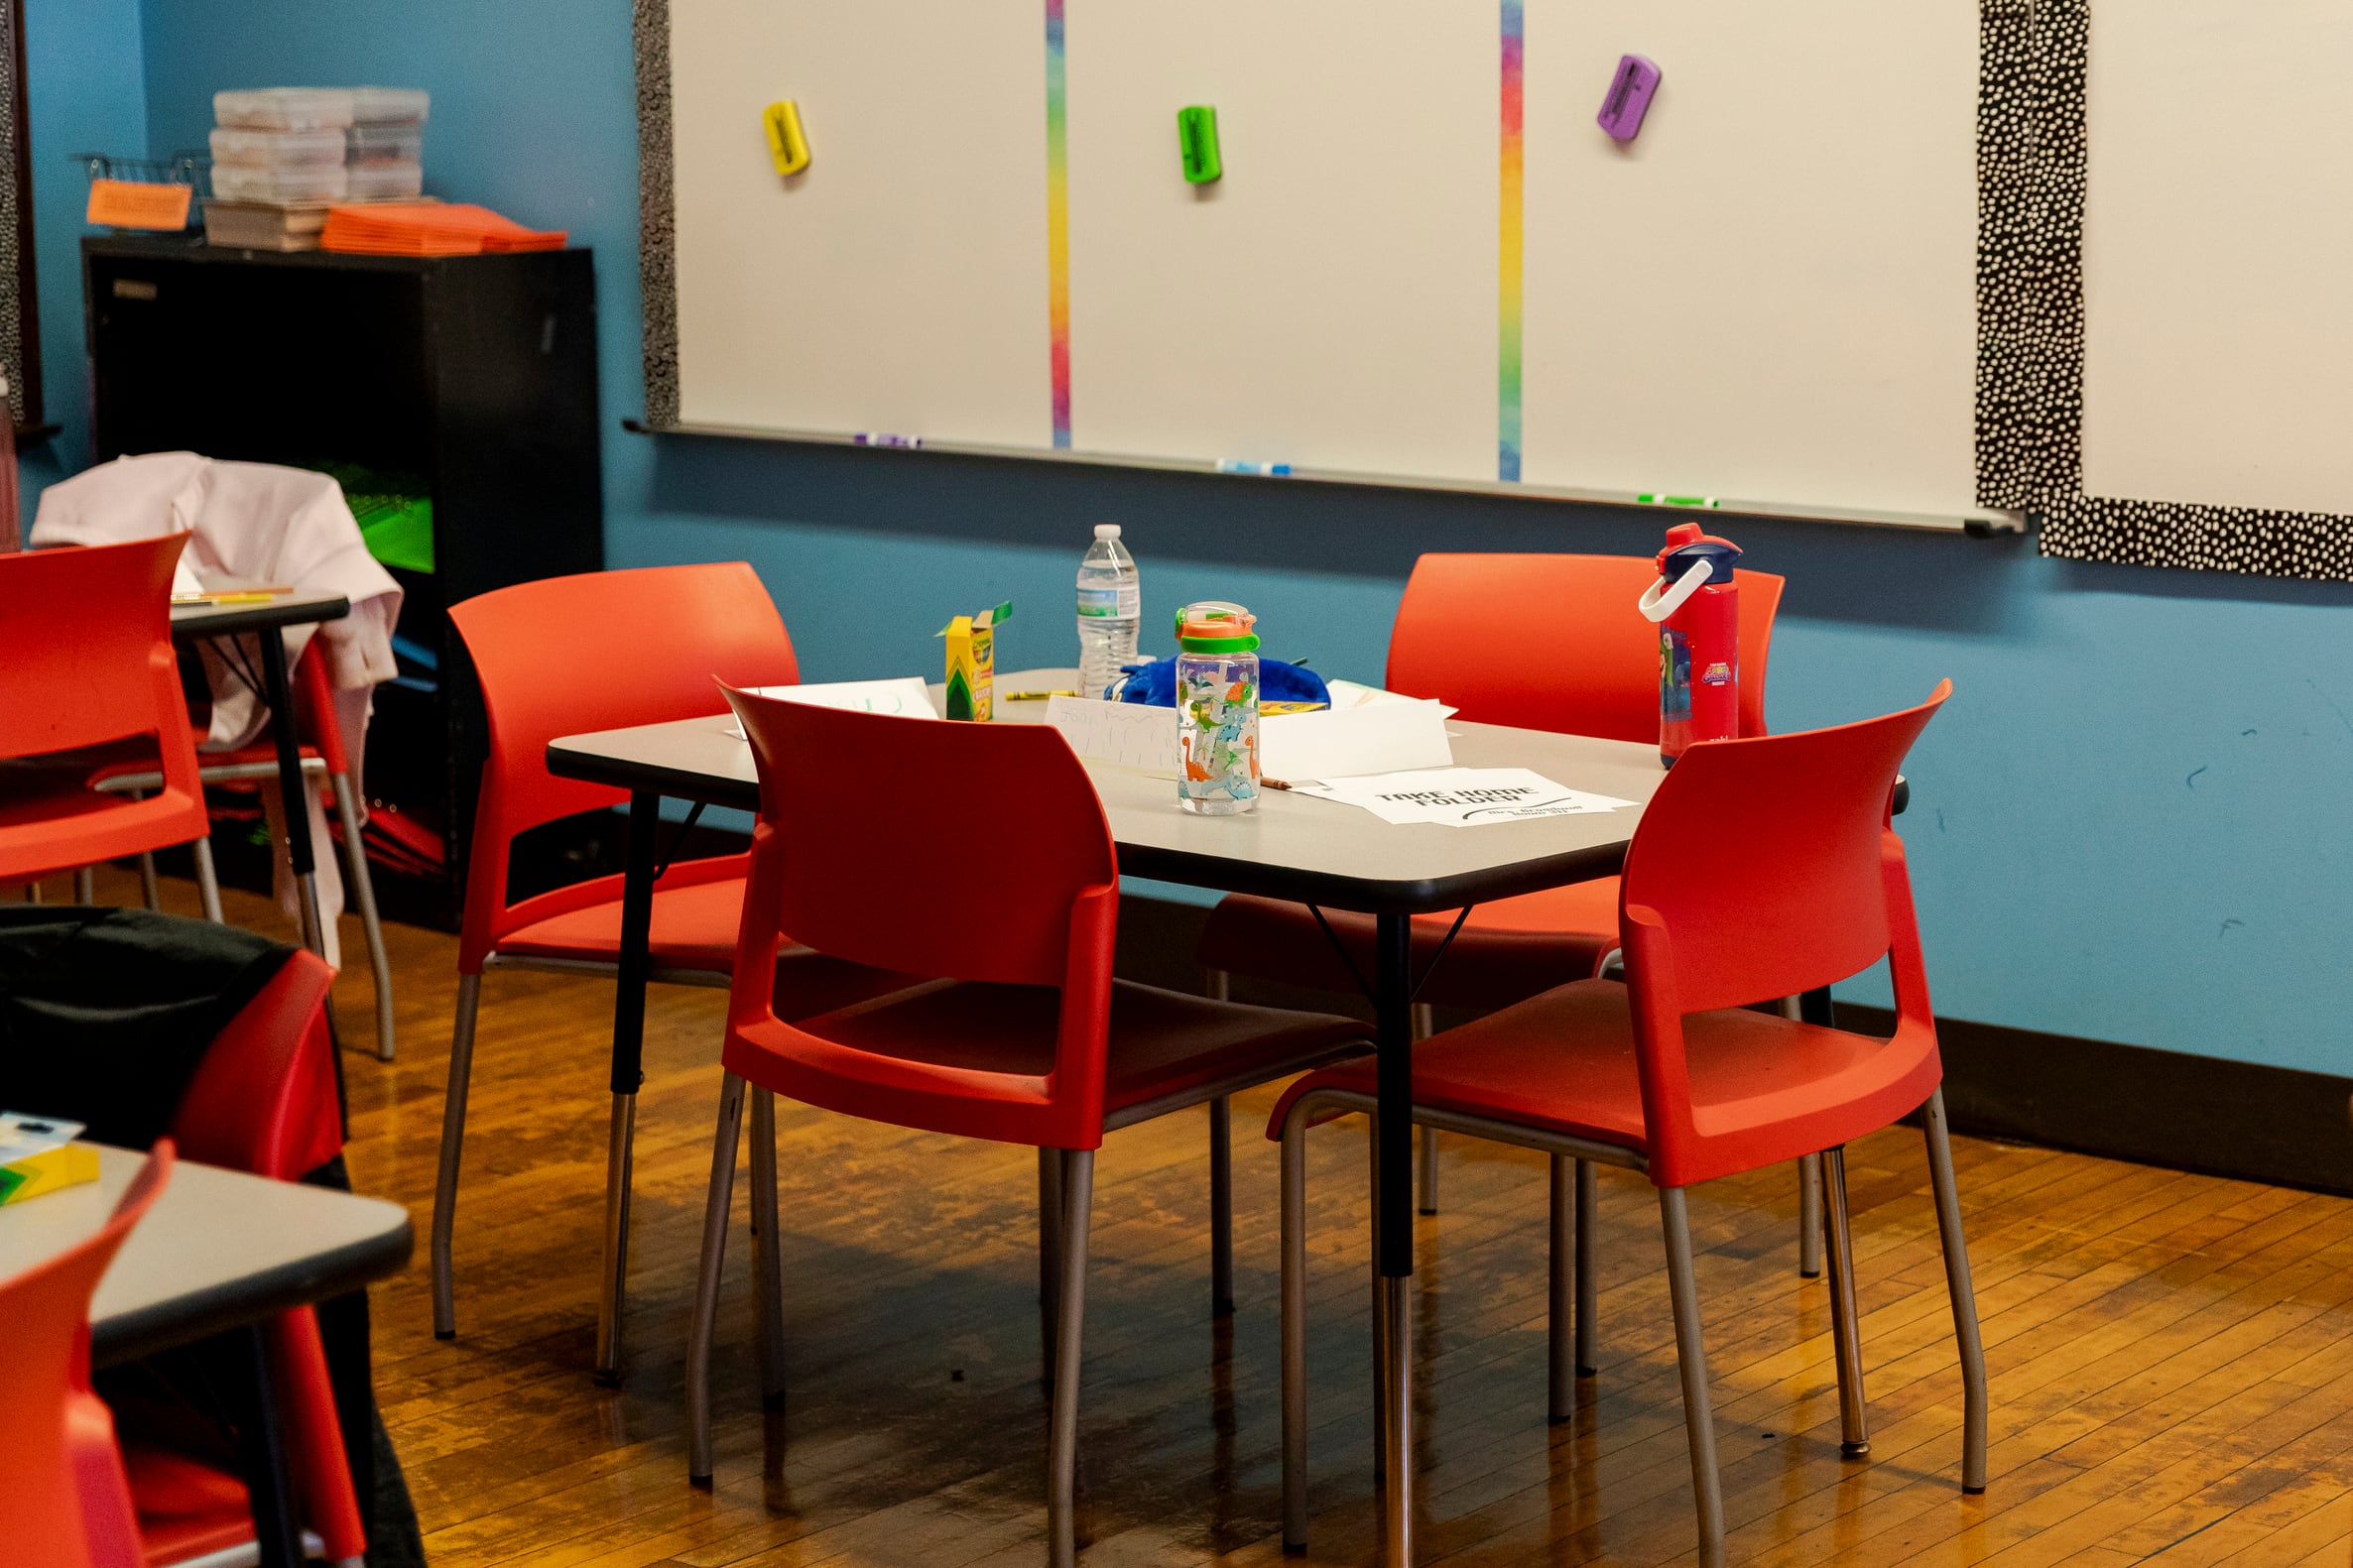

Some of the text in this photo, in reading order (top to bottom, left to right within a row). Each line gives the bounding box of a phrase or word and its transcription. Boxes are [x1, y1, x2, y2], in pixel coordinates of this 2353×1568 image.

[1375, 786, 1539, 801] TAKE HOME
[1415, 794, 1522, 806] FOLDER
